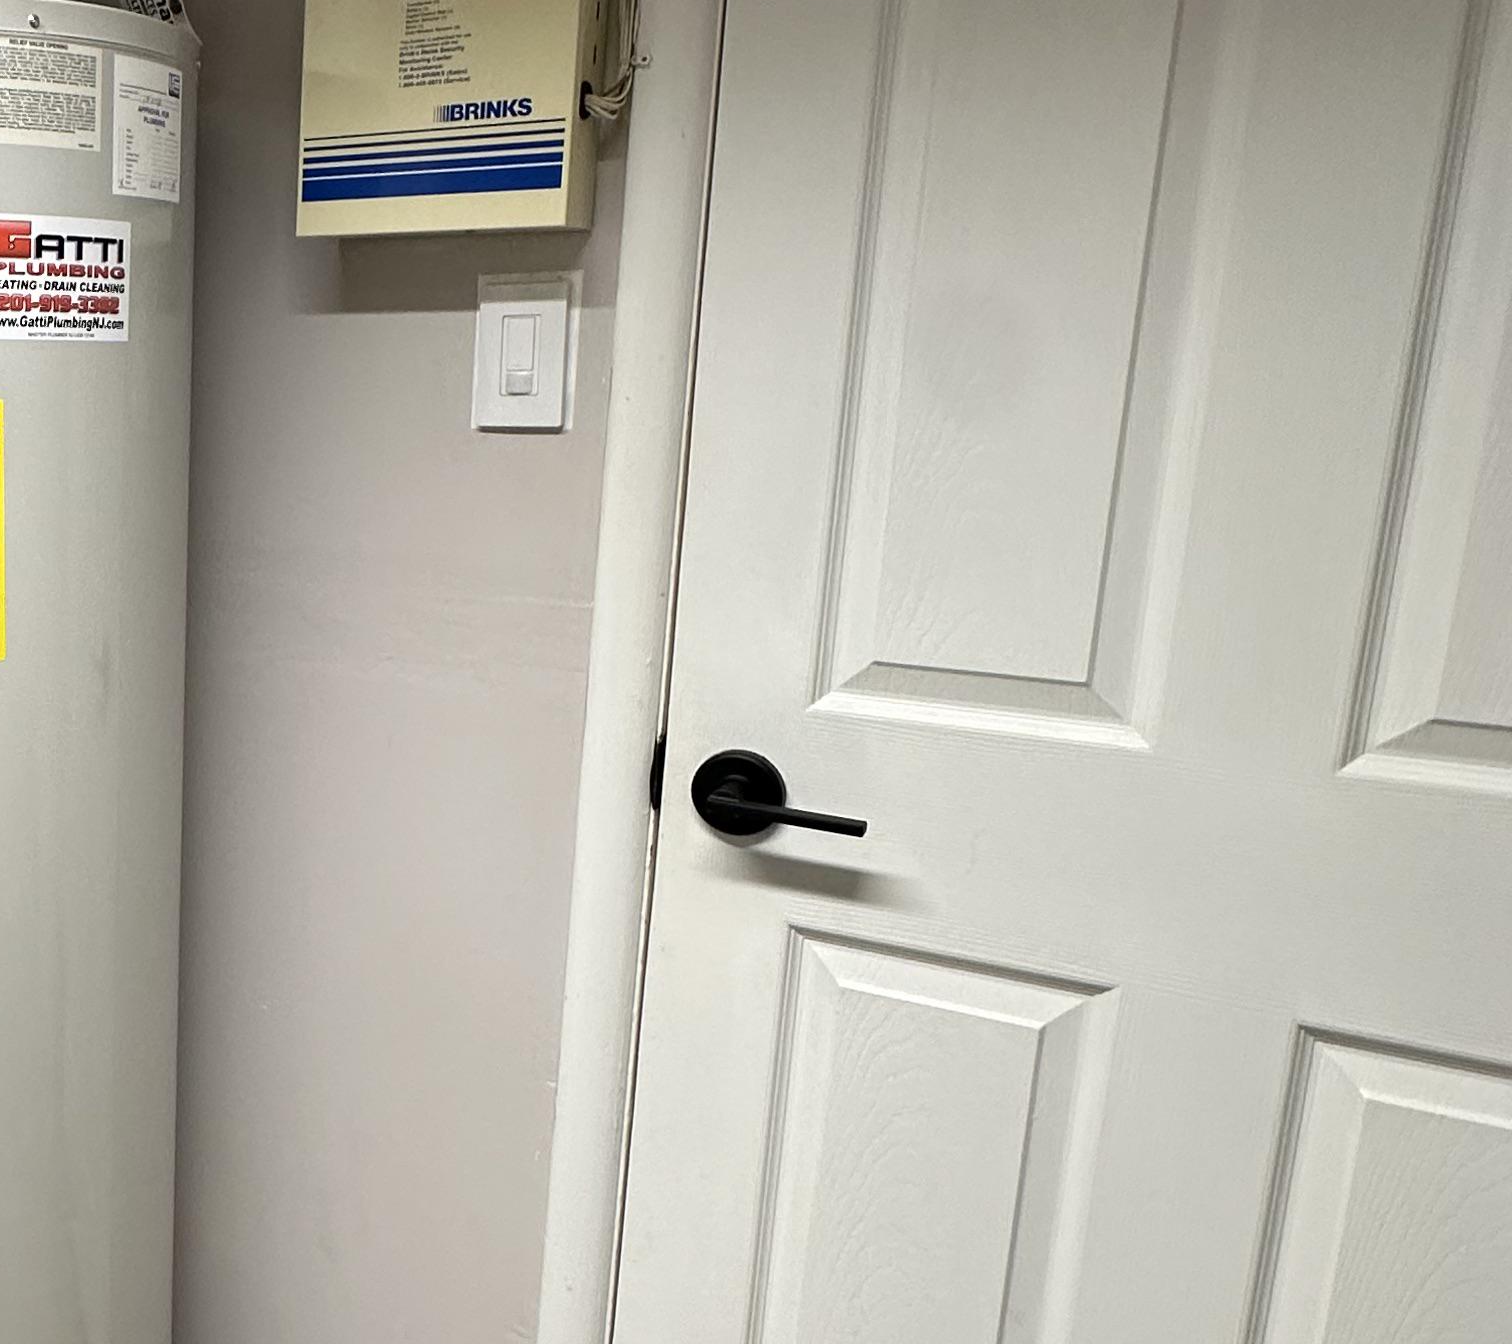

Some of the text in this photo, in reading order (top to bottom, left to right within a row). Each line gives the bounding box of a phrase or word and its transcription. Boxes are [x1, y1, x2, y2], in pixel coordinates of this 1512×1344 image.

[449, 97, 533, 122] BRINKS
[43, 280, 76, 292] DRAIN
[80, 282, 125, 294] CLEANING
